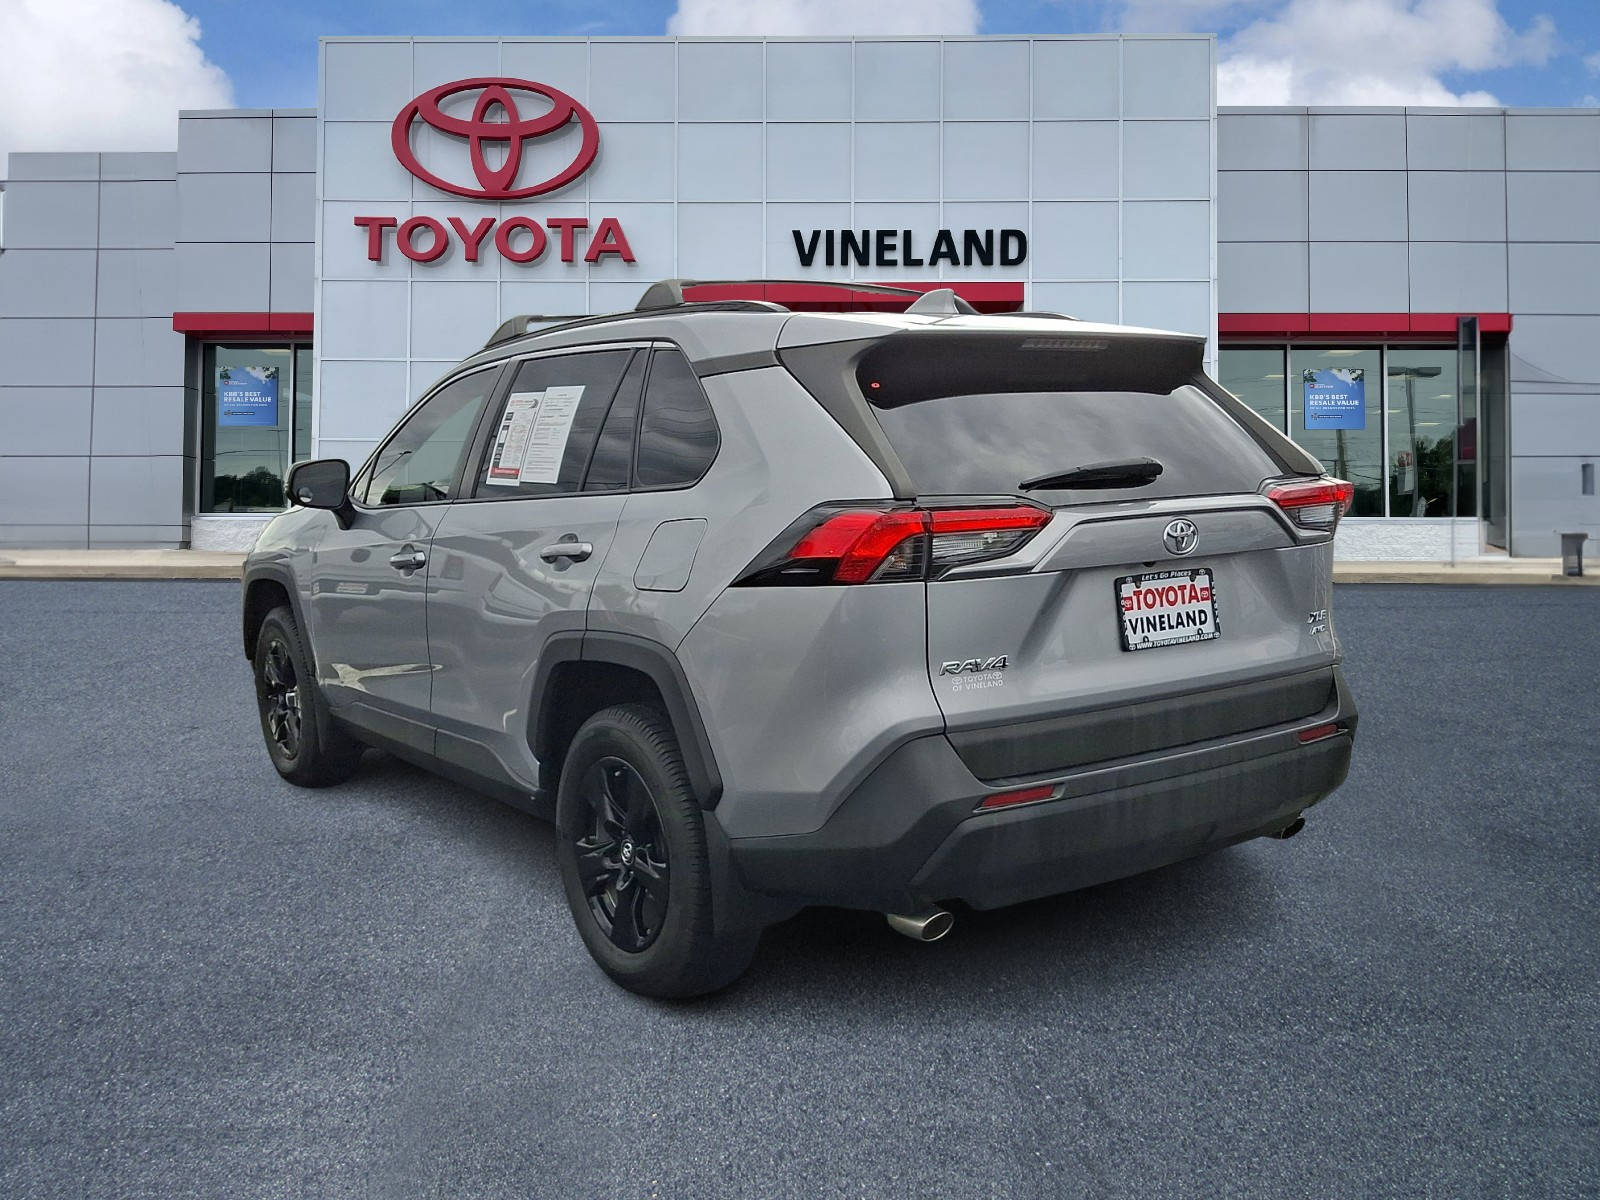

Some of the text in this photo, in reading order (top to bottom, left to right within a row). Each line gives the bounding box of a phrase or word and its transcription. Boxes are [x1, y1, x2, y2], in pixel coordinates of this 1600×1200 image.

[354, 216, 636, 262] TOYOTA
[792, 229, 1027, 266] VINELAND
[1141, 573, 1158, 581] Let's
[1133, 584, 1200, 610] TOYOTA
[1211, 581, 1220, 623] TOYOTA
[1128, 609, 1208, 635] VINELAND
[1137, 633, 1214, 650] WWW.TOYOTAVINELAND.COM
[939, 654, 1009, 676] RAV4
[952, 680, 1004, 692] OF VINELAND
[963, 673, 993, 683] TOYOTA
